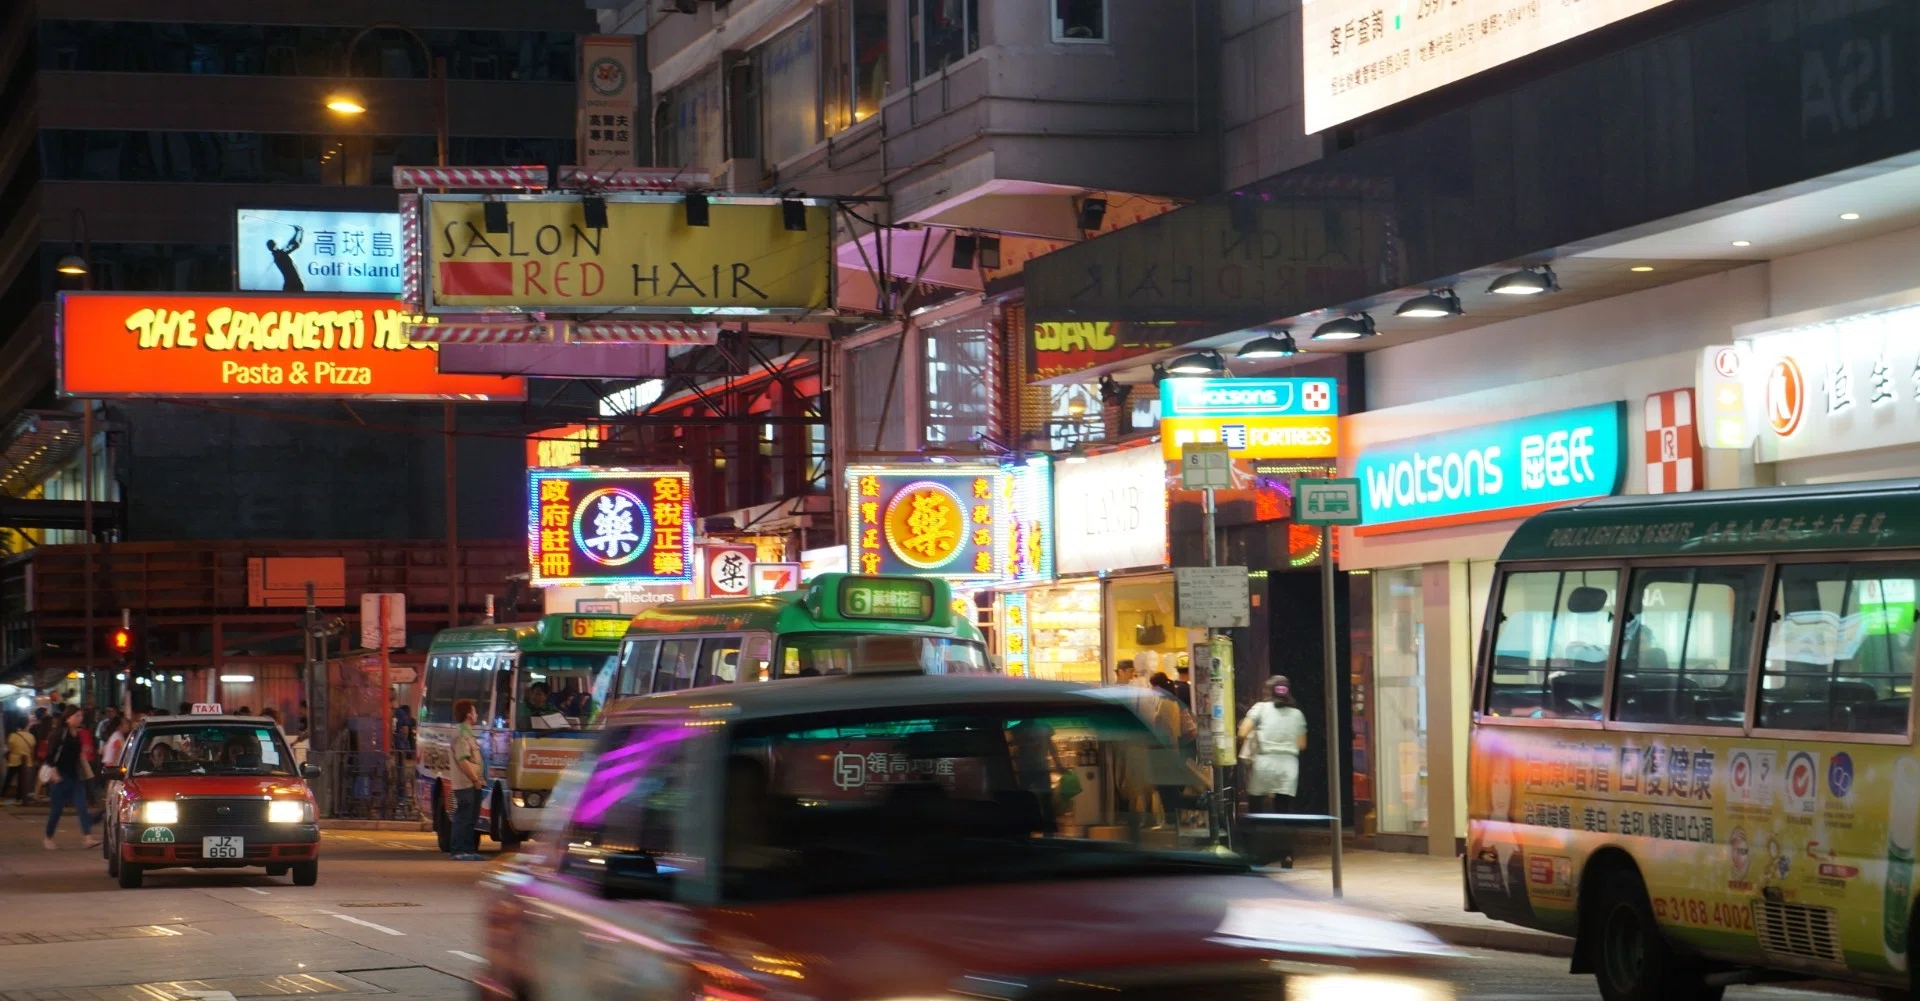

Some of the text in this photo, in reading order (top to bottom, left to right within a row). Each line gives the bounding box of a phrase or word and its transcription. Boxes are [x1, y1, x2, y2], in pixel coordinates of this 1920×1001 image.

[312, 230, 395, 258] 高球島
[443, 221, 602, 258] SALON
[308, 262, 400, 277] Golf island
[522, 259, 769, 300] RED HAIR
[125, 308, 199, 350] THE
[203, 306, 365, 351] SPAGHETTI
[222, 361, 372, 385] Pasta & Pizza
[1250, 427, 1332, 447] FORTRESS
[1191, 455, 1199, 465] 6
[1521, 426, 1595, 492] 屈臣氏
[1366, 446, 1503, 510] watsons
[541, 479, 571, 577] 政府註冊
[849, 590, 867, 613] 6
[195, 705, 220, 713] TAXI
[209, 847, 237, 858] 850
[215, 836, 232, 847] JZ
[1670, 899, 1753, 931] 3188 4002
